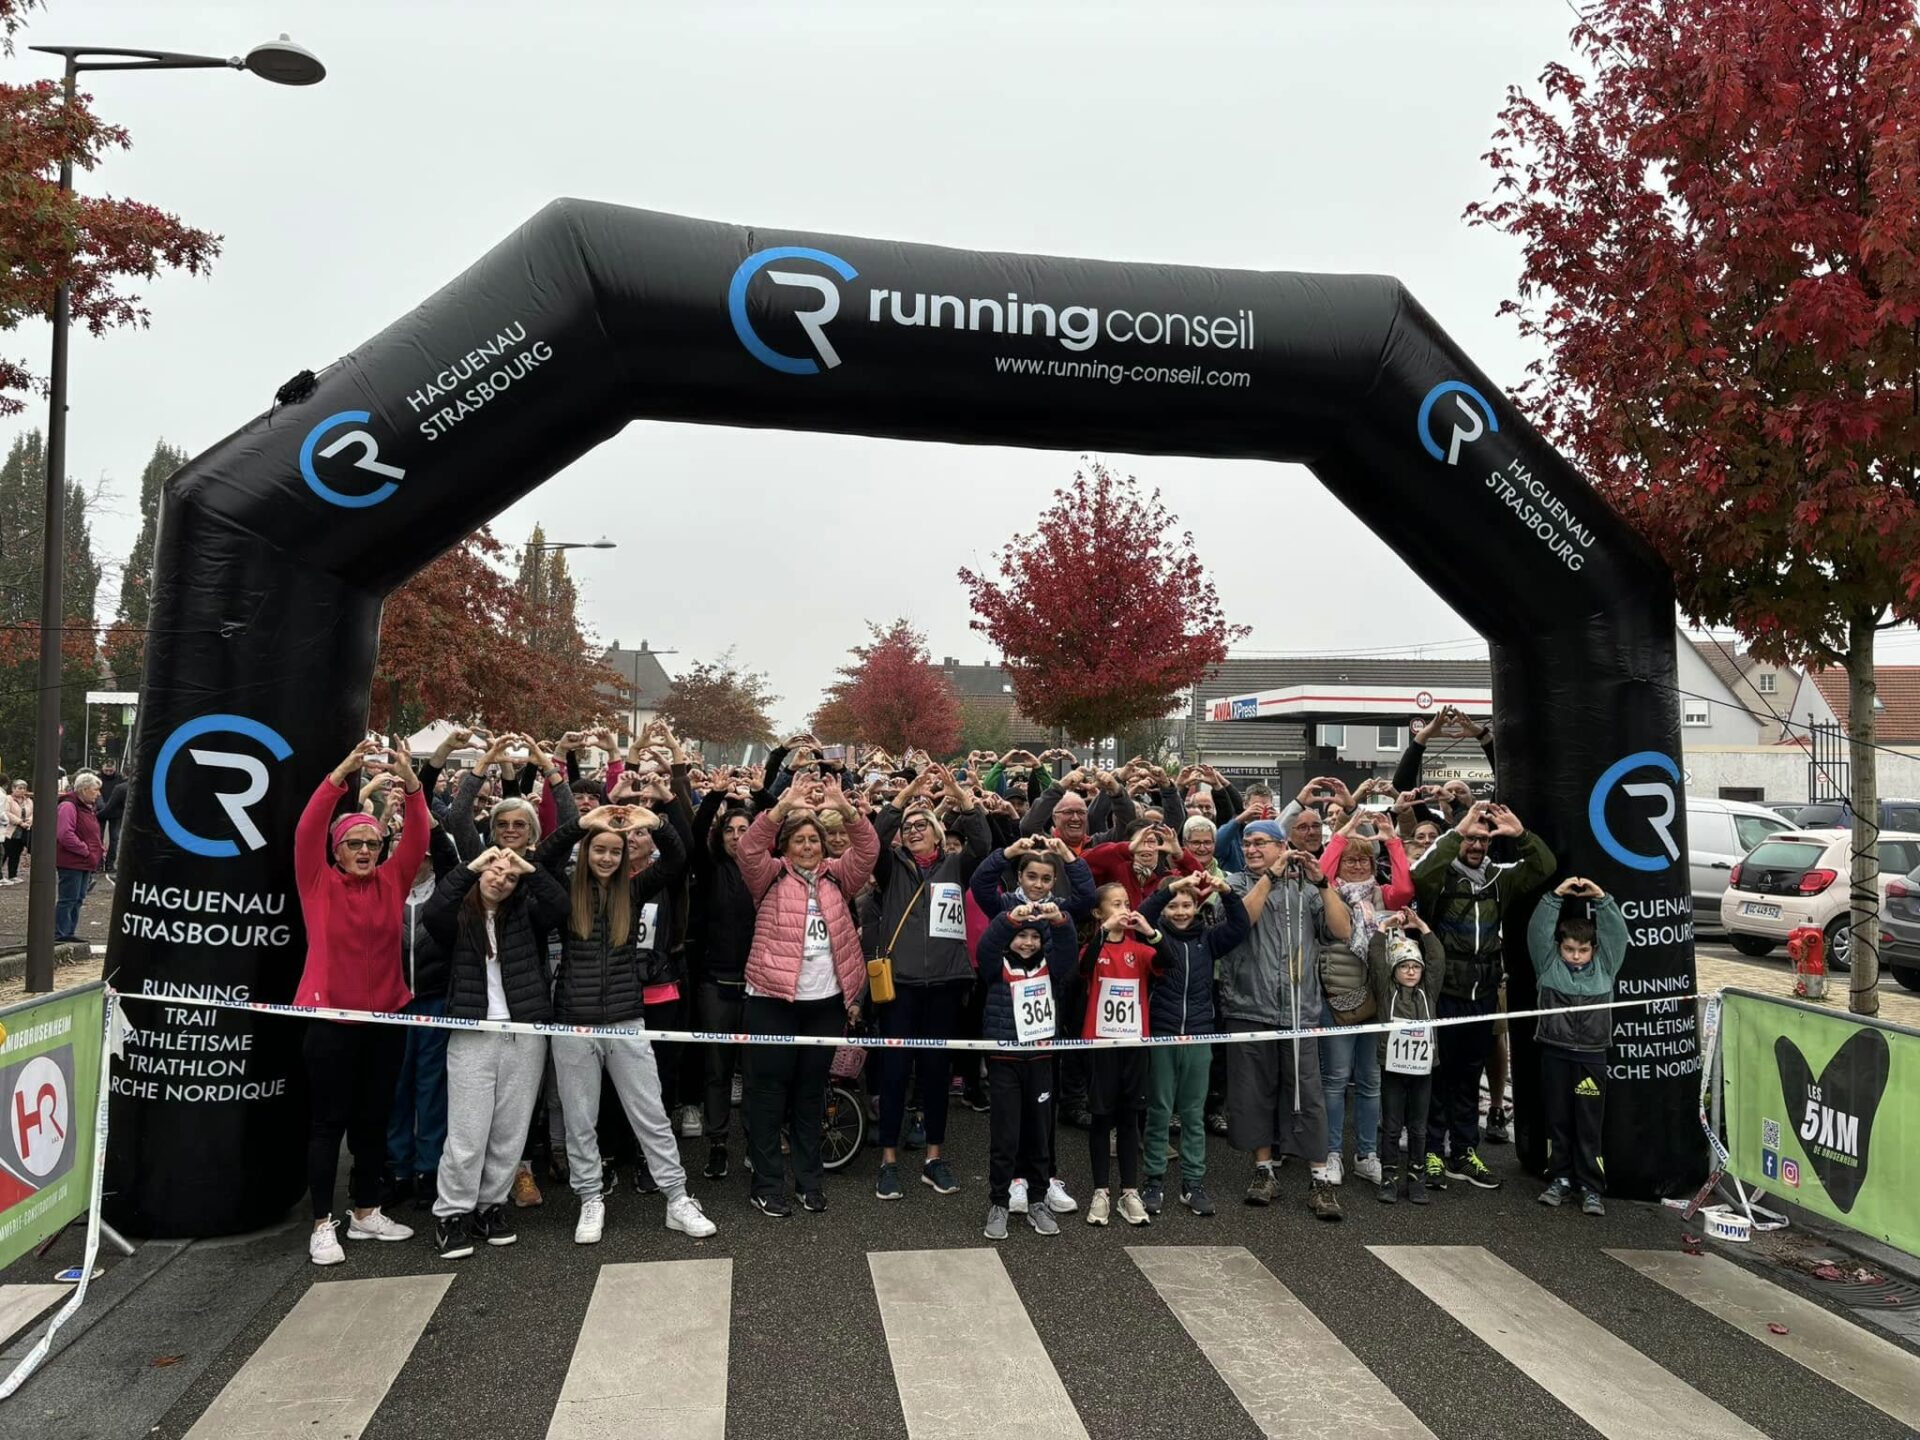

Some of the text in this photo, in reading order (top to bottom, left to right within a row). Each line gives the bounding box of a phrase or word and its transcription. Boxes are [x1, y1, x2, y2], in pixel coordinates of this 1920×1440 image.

[869, 288, 1254, 351] running conseil
[406, 321, 527, 412] HAGUENAU
[995, 357, 1251, 388] www.running-conseil.com
[419, 341, 553, 441] STRASBOURG
[1507, 459, 1596, 548] HAGUENAU
[1485, 471, 1585, 571] STRASBOURG
[131, 881, 285, 915] HAGUENAU
[1586, 895, 1692, 920] HGUENAU
[937, 902, 963, 925] 748
[121, 912, 290, 946] STRASBOURG
[807, 918, 828, 940] 49
[143, 979, 249, 1002] RUNNING
[1619, 974, 1690, 995] RUNNING
[1022, 997, 1052, 1025] 364
[1104, 999, 1134, 1023] 961
[1613, 1015, 1695, 1037] ATHLÉTISME
[128, 1030, 253, 1052] ATHLÉTISME
[1393, 1038, 1428, 1061] 1172
[1616, 1037, 1695, 1058] TRIATHLON
[128, 1054, 246, 1077] TRIATHLON
[109, 1075, 286, 1102] RCHE NORDIQUE
[1807, 1083, 1822, 1102] LES
[1800, 1100, 1859, 1157] 5XM
